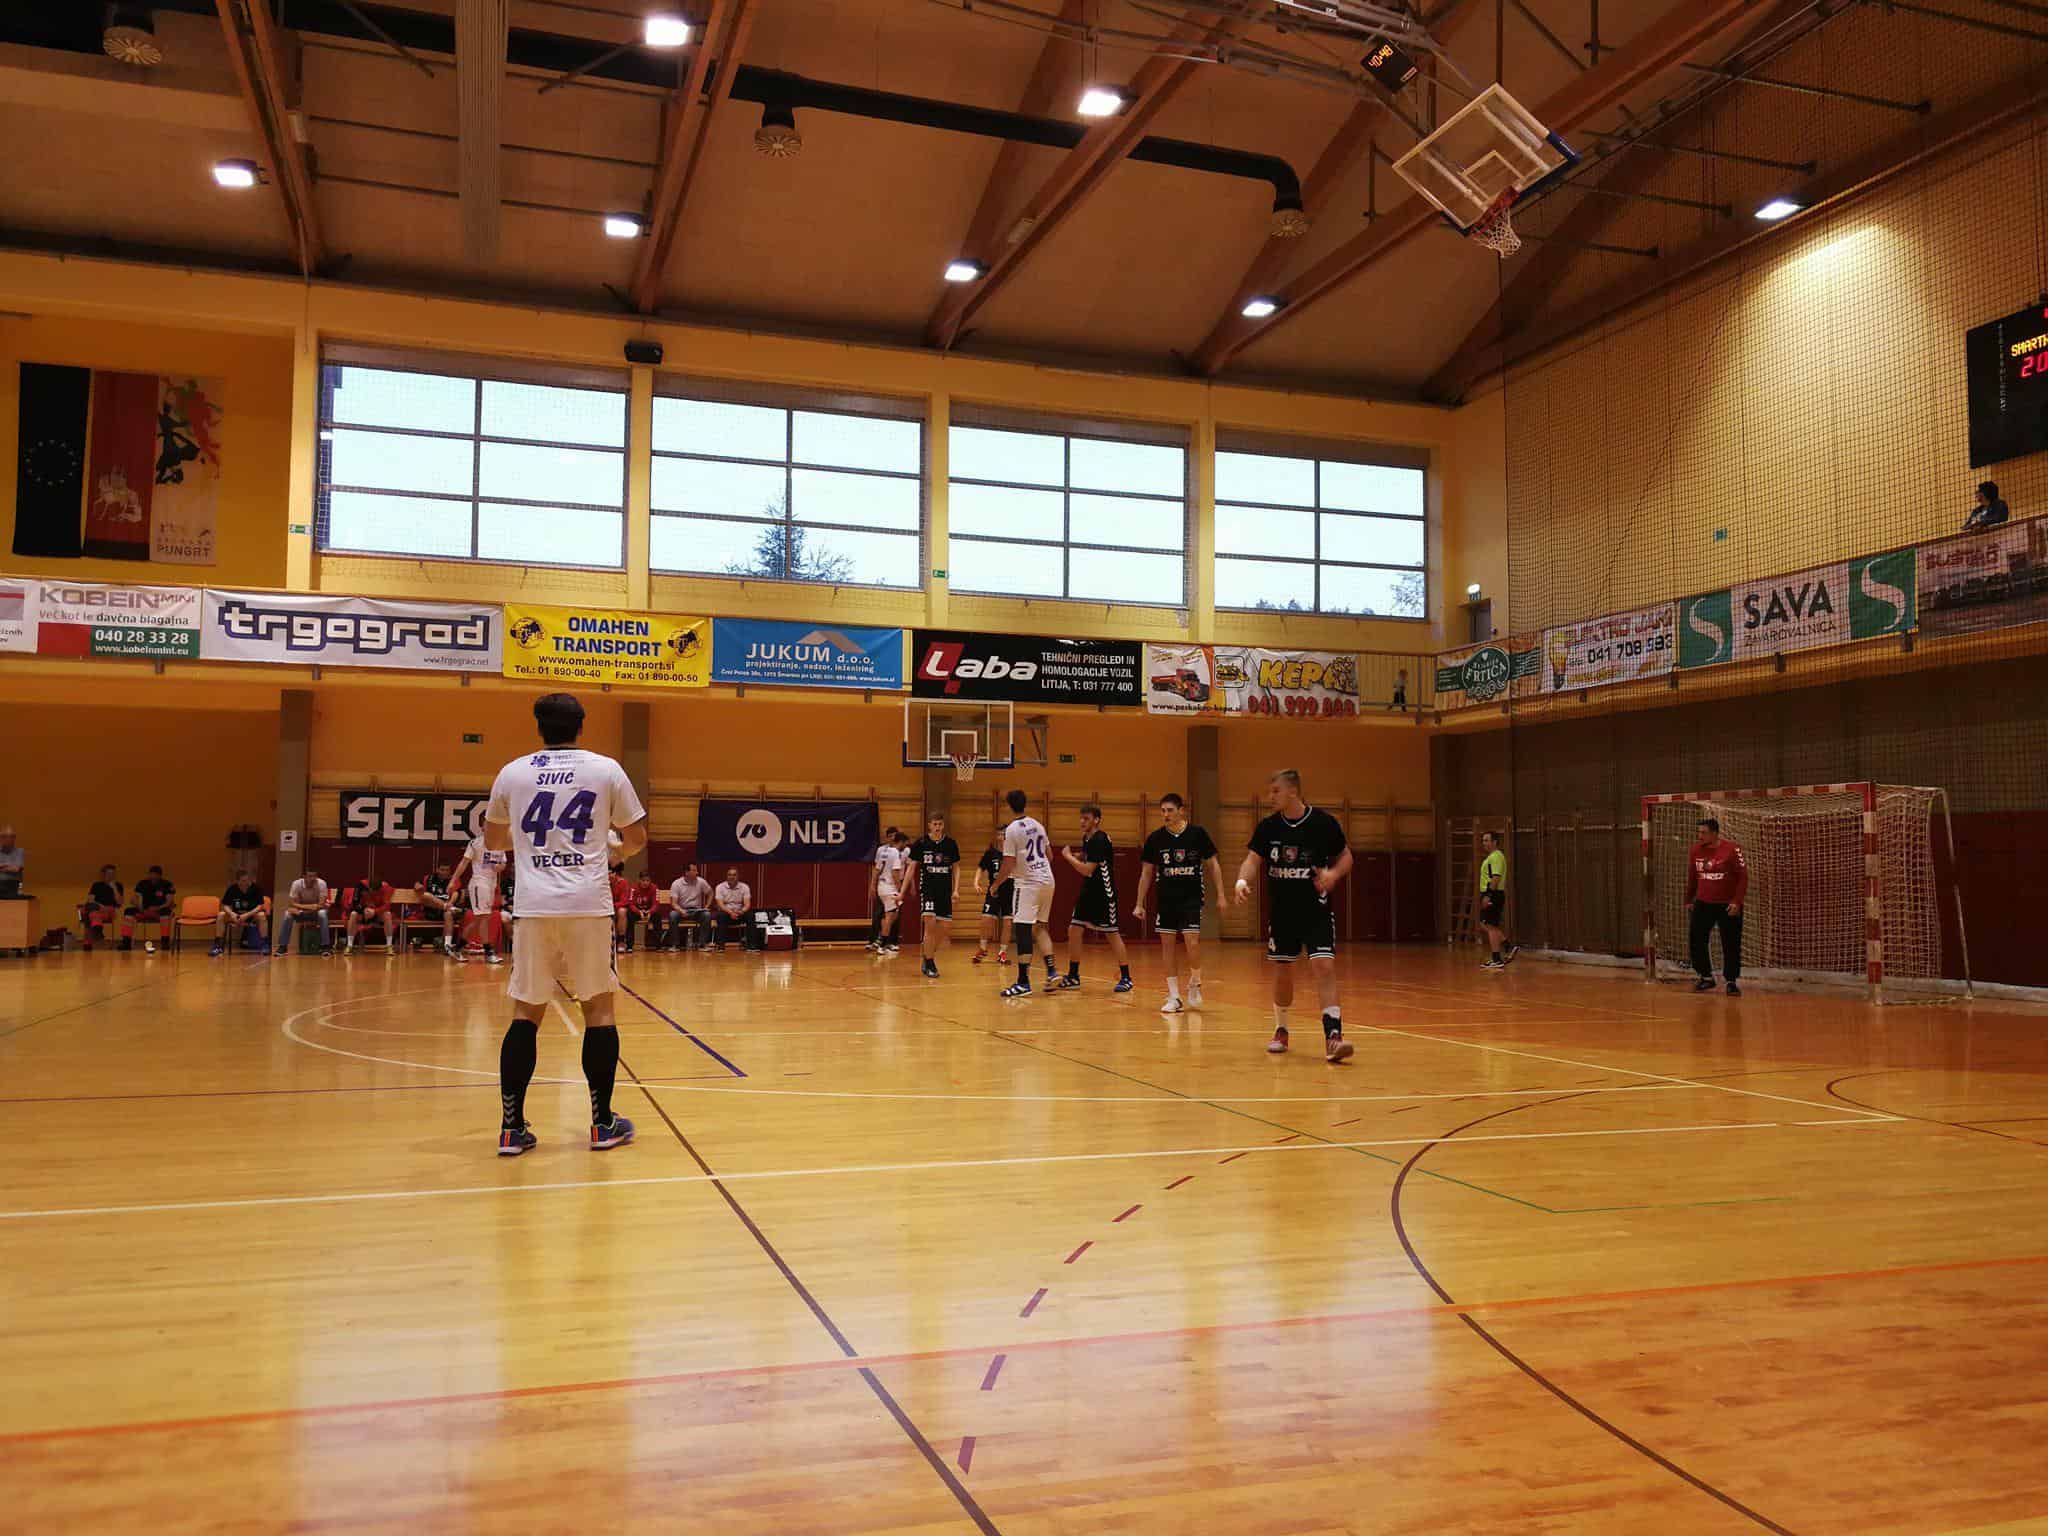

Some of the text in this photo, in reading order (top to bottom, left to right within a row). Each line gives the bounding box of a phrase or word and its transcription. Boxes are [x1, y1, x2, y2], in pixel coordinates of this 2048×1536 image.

[1744, 580, 1833, 629] SAVA
[96, 611, 136, 624] davčna
[140, 614, 189, 627] blagajna
[218, 601, 489, 654] trgograd
[568, 617, 649, 636] OMAHEN
[95, 629, 189, 644] 040 28 33 28
[1744, 620, 1837, 647] ZAVAROVALNICA
[95, 644, 189, 656] www.kobeinmini.eu
[552, 636, 662, 657] TRANSPORT
[746, 643, 875, 665] JUKUM d.o.o.
[1587, 645, 1612, 664] 041
[1616, 640, 1642, 659] 708
[423, 655, 489, 667] www.trgograd.net
[539, 655, 675, 671] www.omahen-transport.si
[926, 650, 1039, 682] Laba
[1041, 652, 1135, 665] TEHNIČNI PREGLEDI IN
[538, 665, 549, 675] 01
[615, 671, 635, 680] Fax:
[638, 672, 649, 680] 01
[1041, 664, 1134, 678] HOMOLOGACIJE VOZIL
[1072, 681, 1081, 690] T:
[1083, 681, 1098, 691] 031
[1100, 682, 1116, 691] 777
[1117, 682, 1134, 692] 400
[347, 797, 487, 841] SELEC
[521, 791, 597, 847] 44
[789, 820, 846, 844] NLB
[531, 851, 585, 868] VEČER
[1270, 847, 1280, 862] 4
